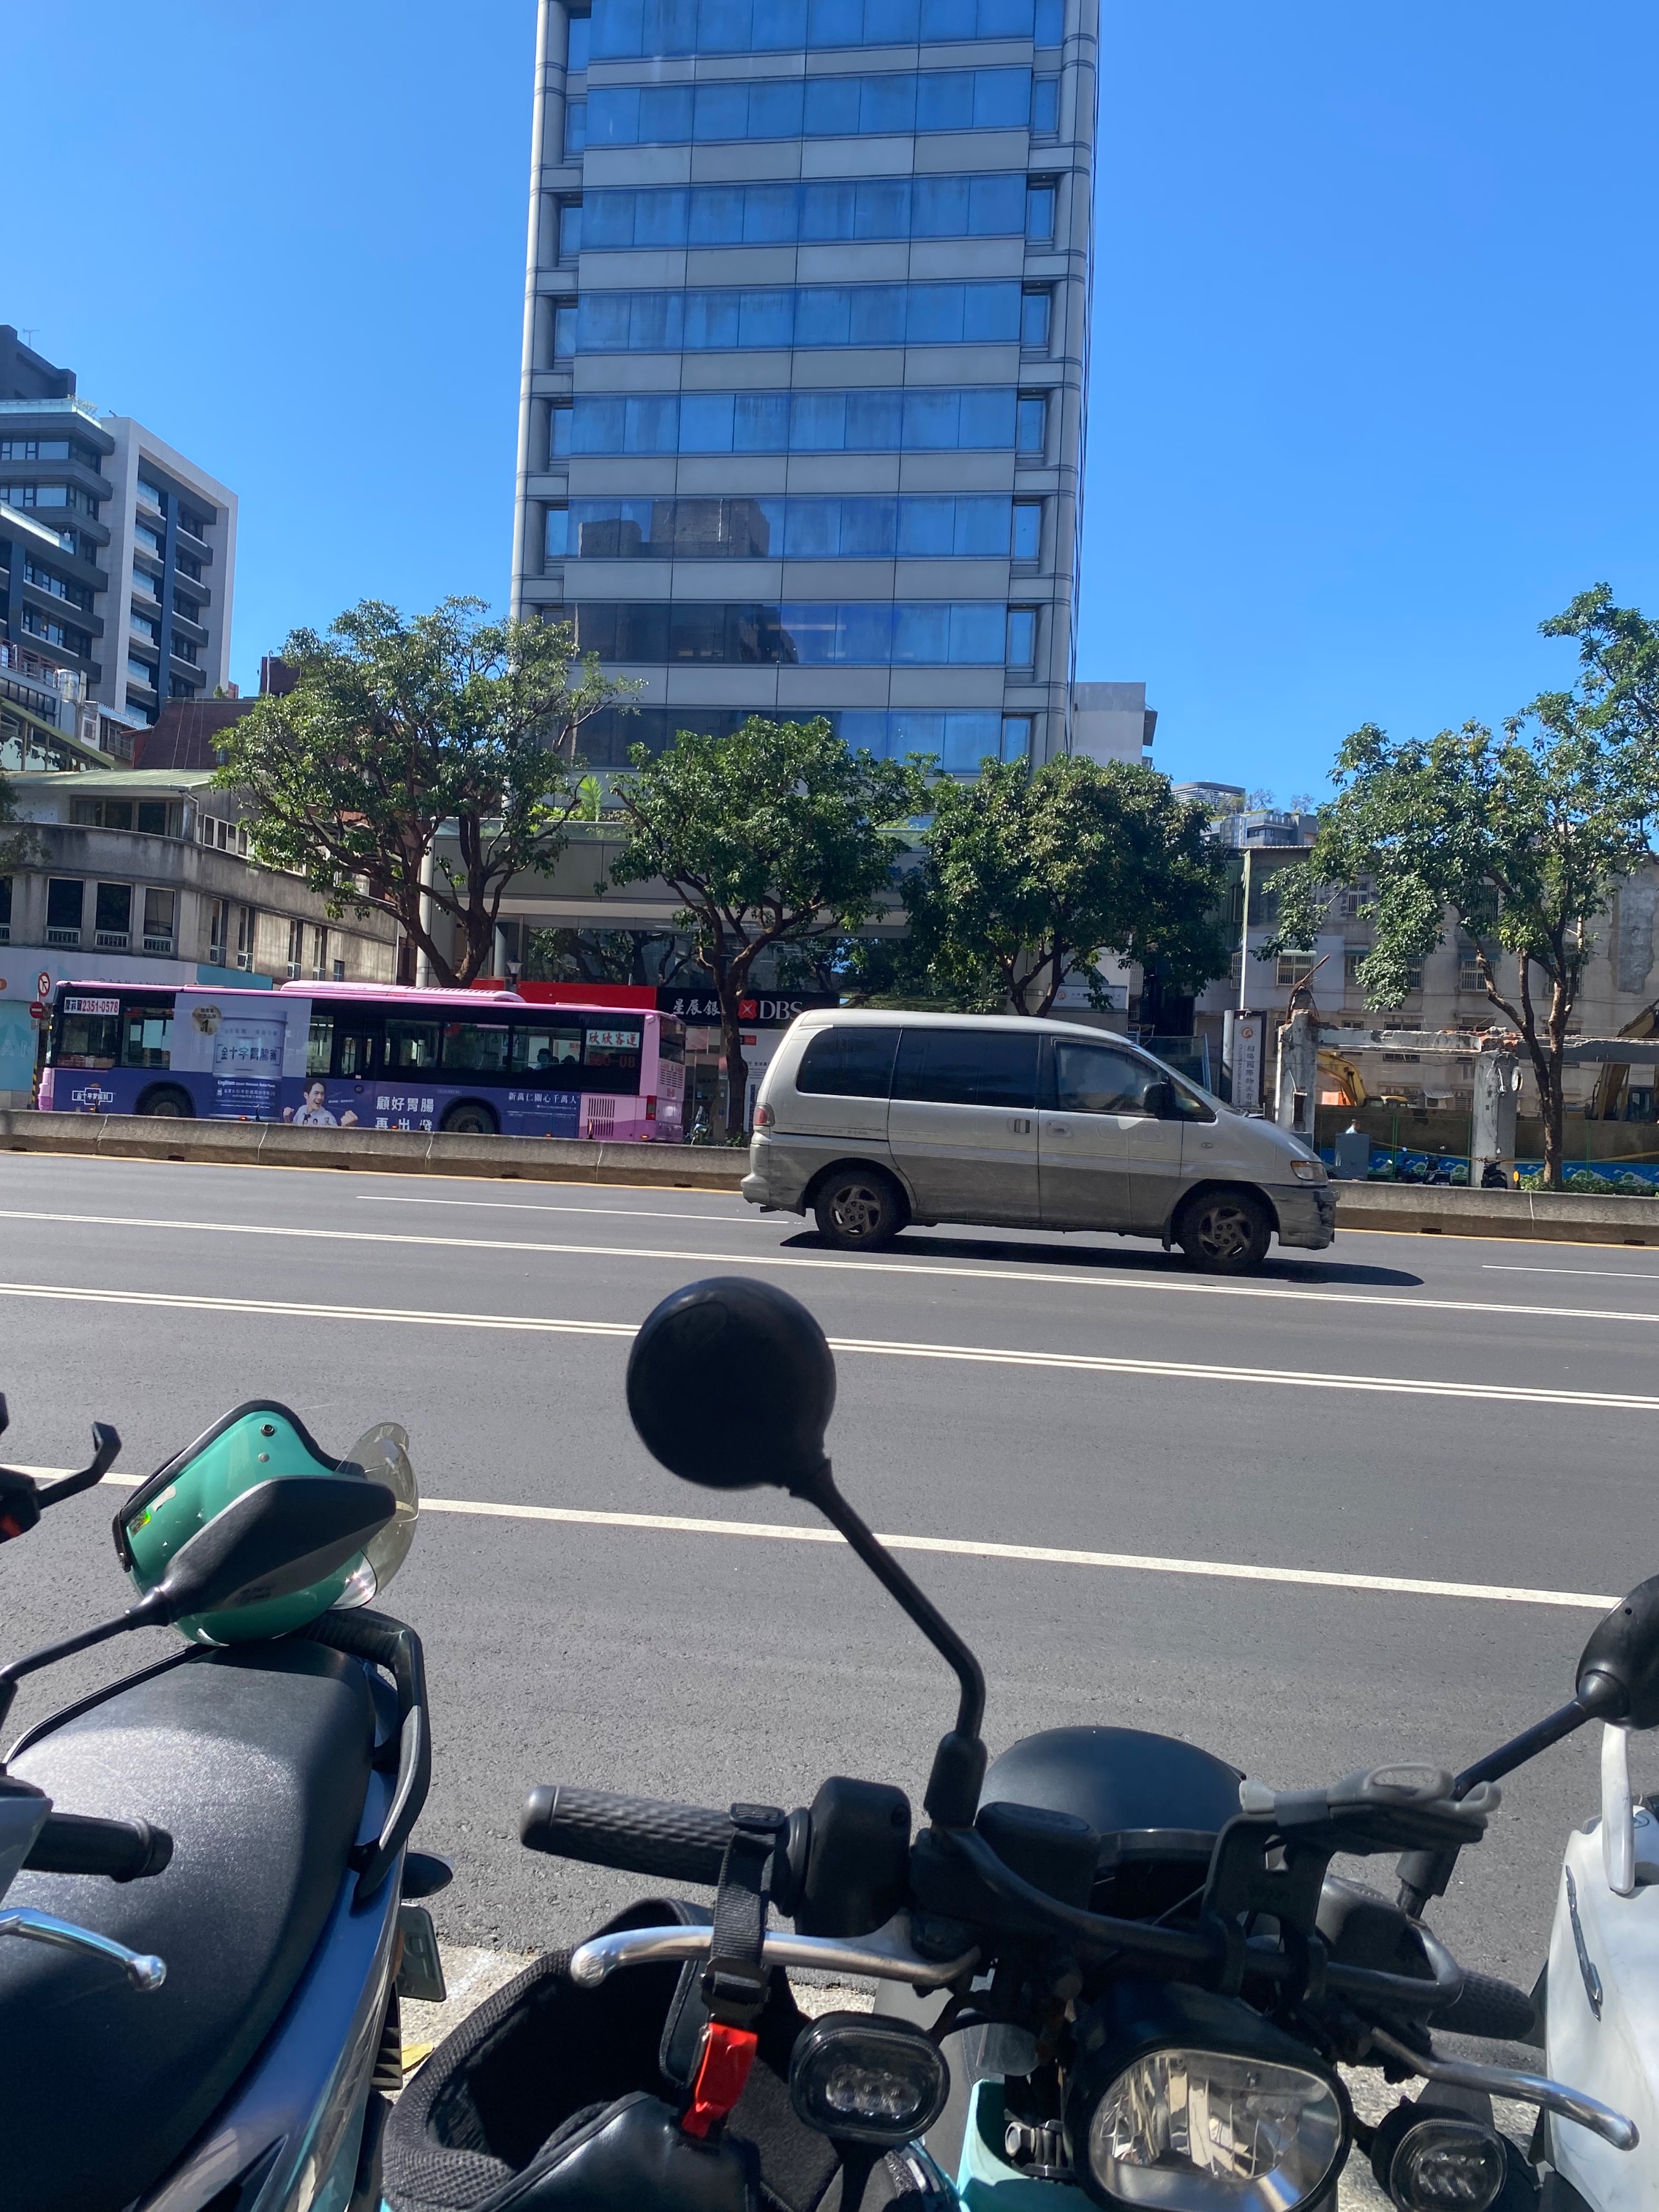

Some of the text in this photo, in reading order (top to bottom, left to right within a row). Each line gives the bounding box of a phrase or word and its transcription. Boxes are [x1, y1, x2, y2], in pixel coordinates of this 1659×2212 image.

[759, 1000, 803, 1020] DBS
[589, 1031, 637, 1047] 欣欣客運
[220, 1046, 278, 1062] 金十字胃腸藥
[376, 1096, 434, 1113] 顧好胃腸
